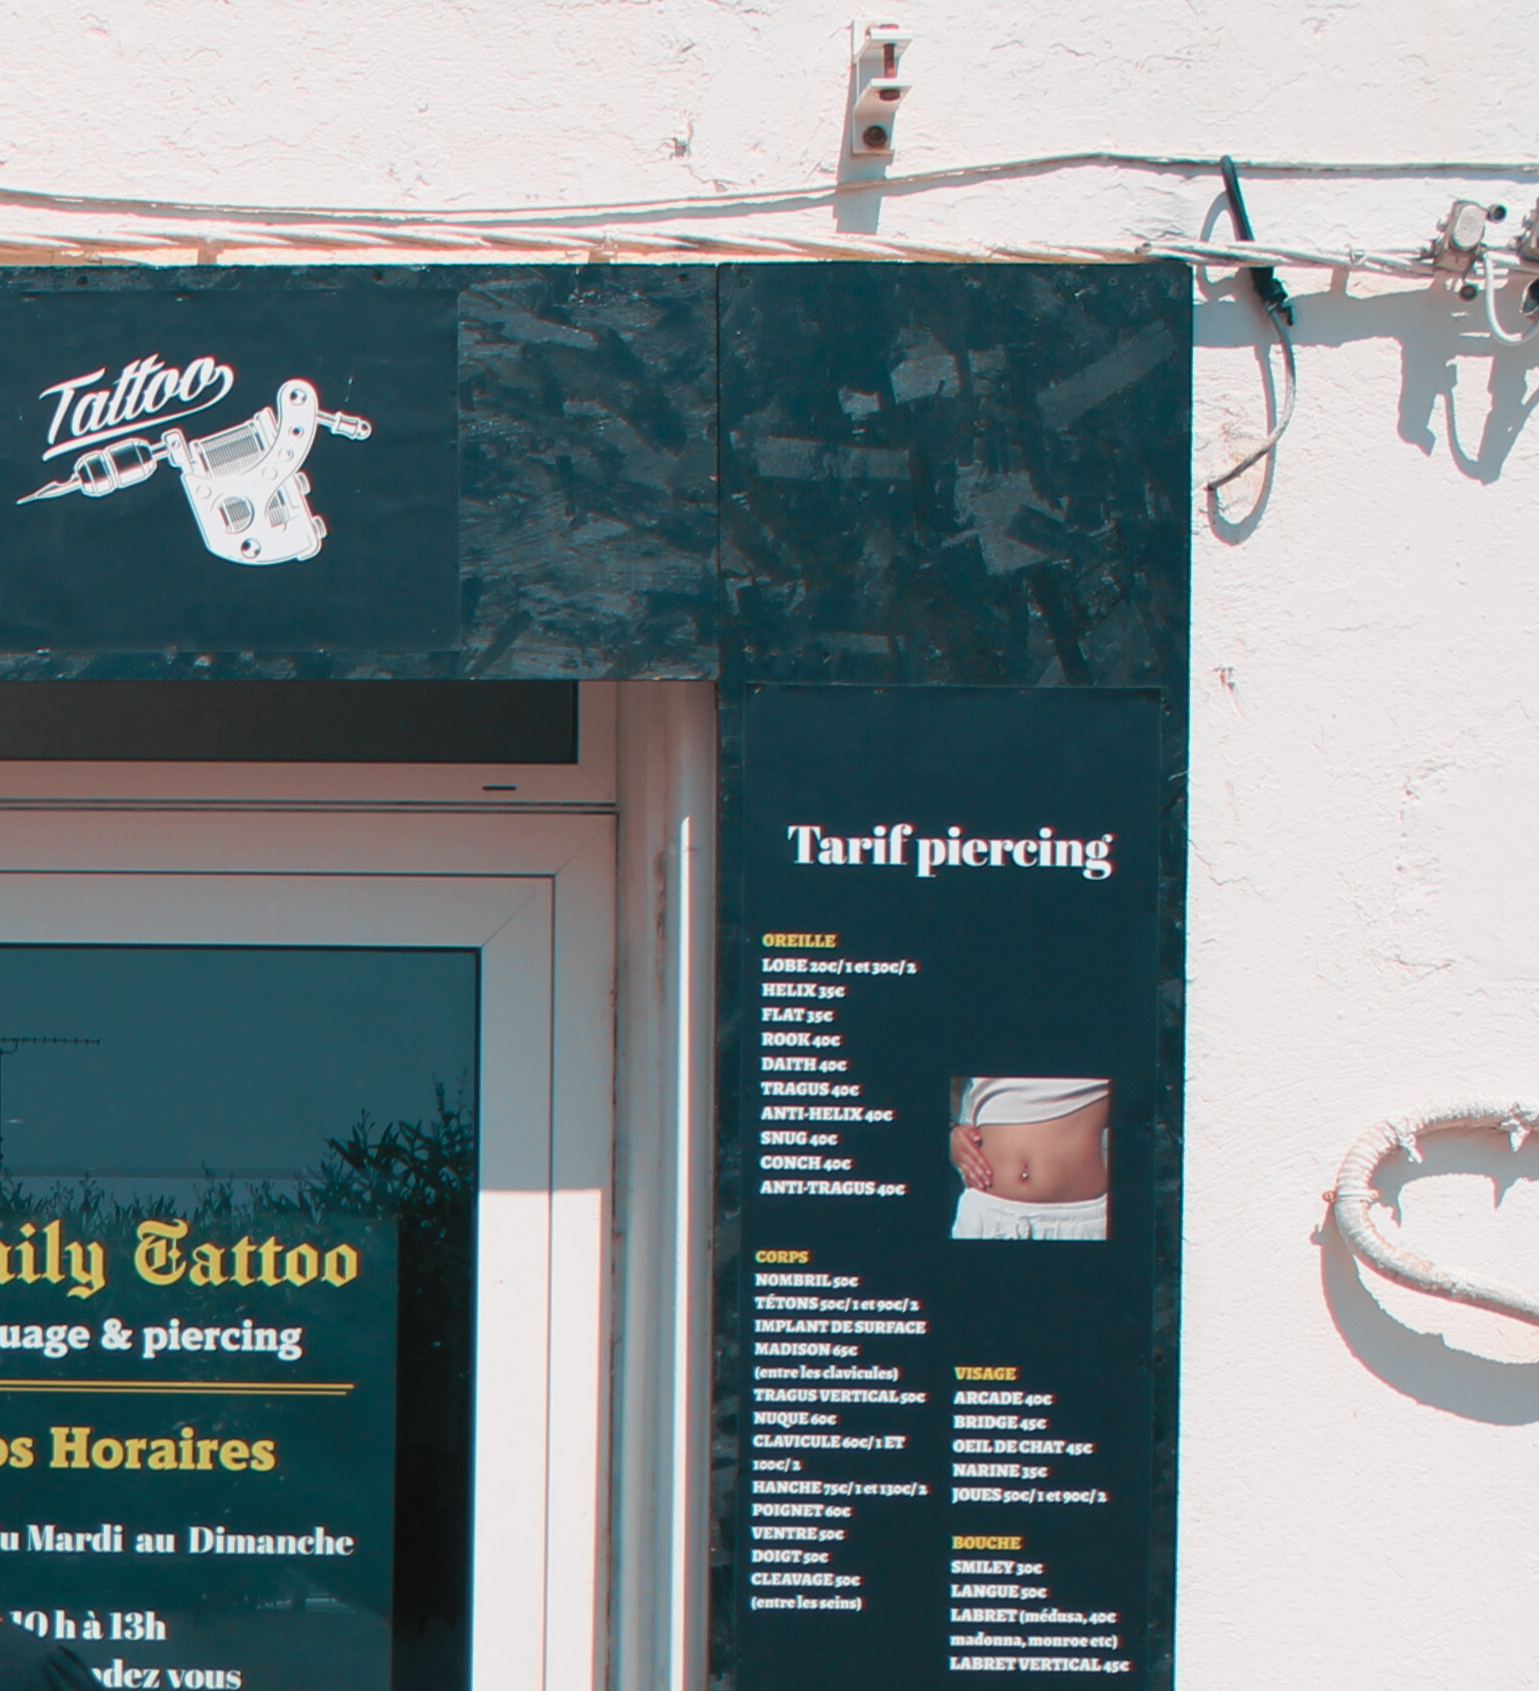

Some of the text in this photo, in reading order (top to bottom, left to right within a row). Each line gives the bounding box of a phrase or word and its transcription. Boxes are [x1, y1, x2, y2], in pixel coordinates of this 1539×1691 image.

[37, 354, 235, 460] Tattoo
[787, 824, 1113, 880] Tarif piercing
[762, 934, 836, 948] OREILLE
[762, 984, 816, 997] HELIX
[762, 1009, 804, 1022] FLAT
[761, 1033, 810, 1047] ROOK
[762, 1057, 815, 1071] DAITH
[762, 1082, 829, 1096] TRAGUS
[762, 1106, 863, 1120] ANTI-HELIX
[761, 1132, 806, 1145] SNUG
[761, 1156, 821, 1170] CONCH
[761, 1181, 874, 1195] ANTI-TRAGUS
[134, 1218, 358, 1287] Tattoo
[756, 1250, 808, 1264] CORPS
[756, 1274, 831, 1287] NOMBRIL
[755, 1320, 927, 1334] IMPLANT DE SURFACE
[102, 1321, 131, 1350] &
[143, 1318, 302, 1360] piercing
[755, 1344, 831, 1356] MADISON
[955, 1367, 1016, 1380] VISAGE
[954, 1392, 1023, 1405] ARCADE
[50, 1426, 275, 1471] Horaires
[953, 1440, 992, 1454] OEIL
[994, 1440, 1016, 1454] DE
[1019, 1440, 1065, 1454] CHAT
[753, 1504, 823, 1518] POIGNET
[27, 1523, 122, 1554] Mardi
[136, 1533, 175, 1555] au
[189, 1526, 354, 1557] Dimanche
[752, 1527, 817, 1541] VENTRE
[953, 1536, 1021, 1550] BOUCHE
[952, 1560, 1014, 1574] SMILEY
[752, 1573, 833, 1587] CLEAVAGE
[951, 1585, 1019, 1598] LANGUE
[168, 1667, 242, 1691] vous
